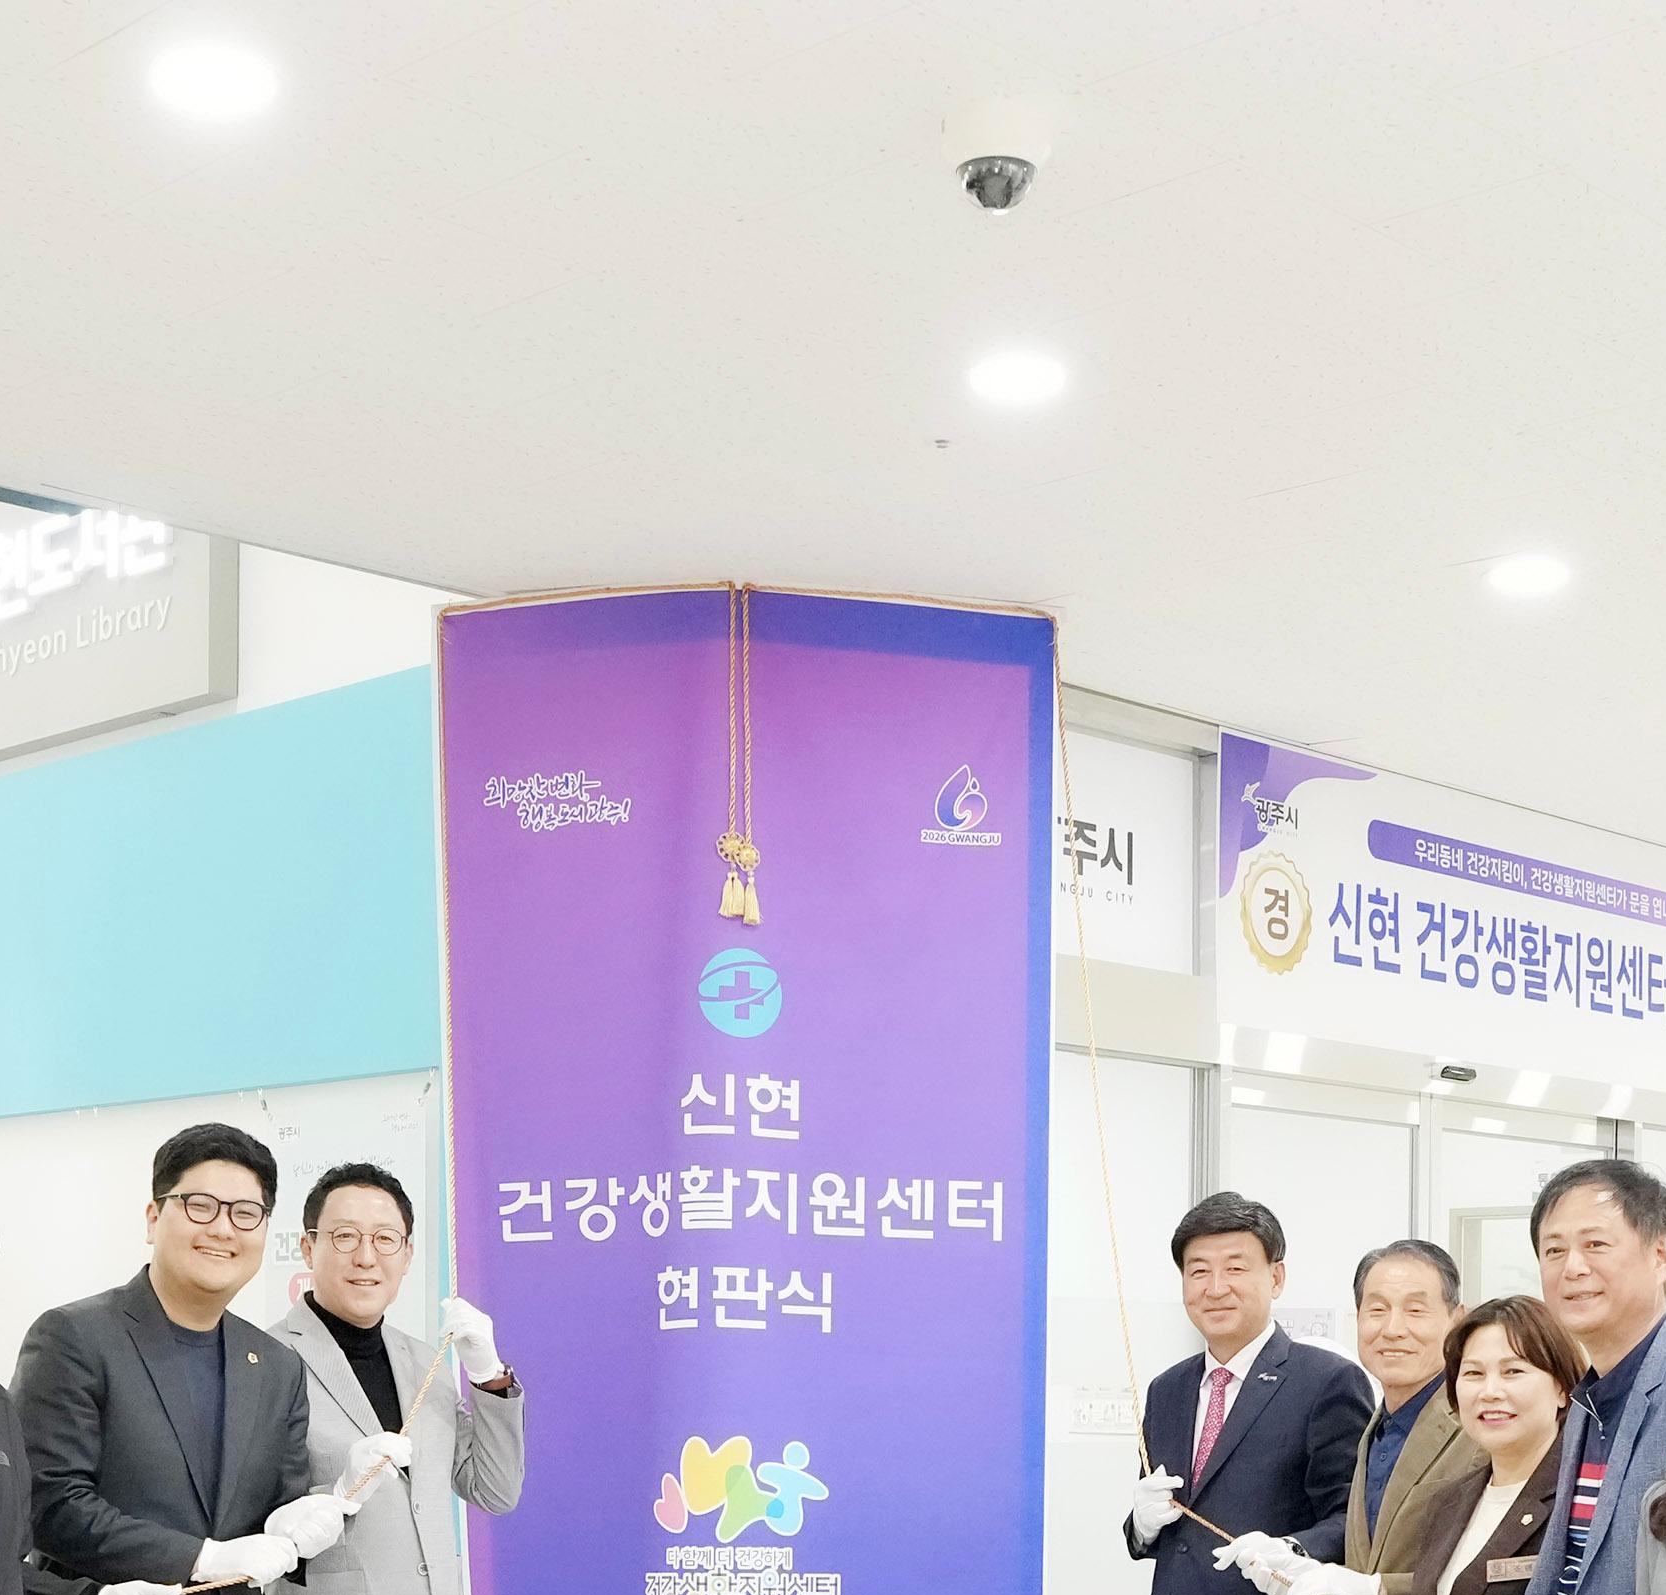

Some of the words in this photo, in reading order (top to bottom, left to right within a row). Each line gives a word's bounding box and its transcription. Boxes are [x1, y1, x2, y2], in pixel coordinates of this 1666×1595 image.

[76, 596, 172, 649] Library
[921, 830, 947, 842] 2026
[947, 832, 1001, 845] GWANGJU
[1255, 799, 1298, 830] 광주시
[1057, 817, 1134, 886] 주시
[1414, 839, 1464, 872] 우리동네
[1466, 852, 1528, 890] 건강지킴이,
[1530, 867, 1628, 910] 건강생활지원센터가
[1629, 891, 1651, 916] 문을
[1105, 890, 1135, 905] CITY
[1261, 885, 1292, 942] 경
[1328, 882, 1402, 975] 신현
[679, 1071, 802, 1140] 신현
[497, 1163, 1005, 1243] 건강생활지원센터
[656, 1263, 835, 1334] 현판식
[737, 1549, 791, 1568] 건강하게
